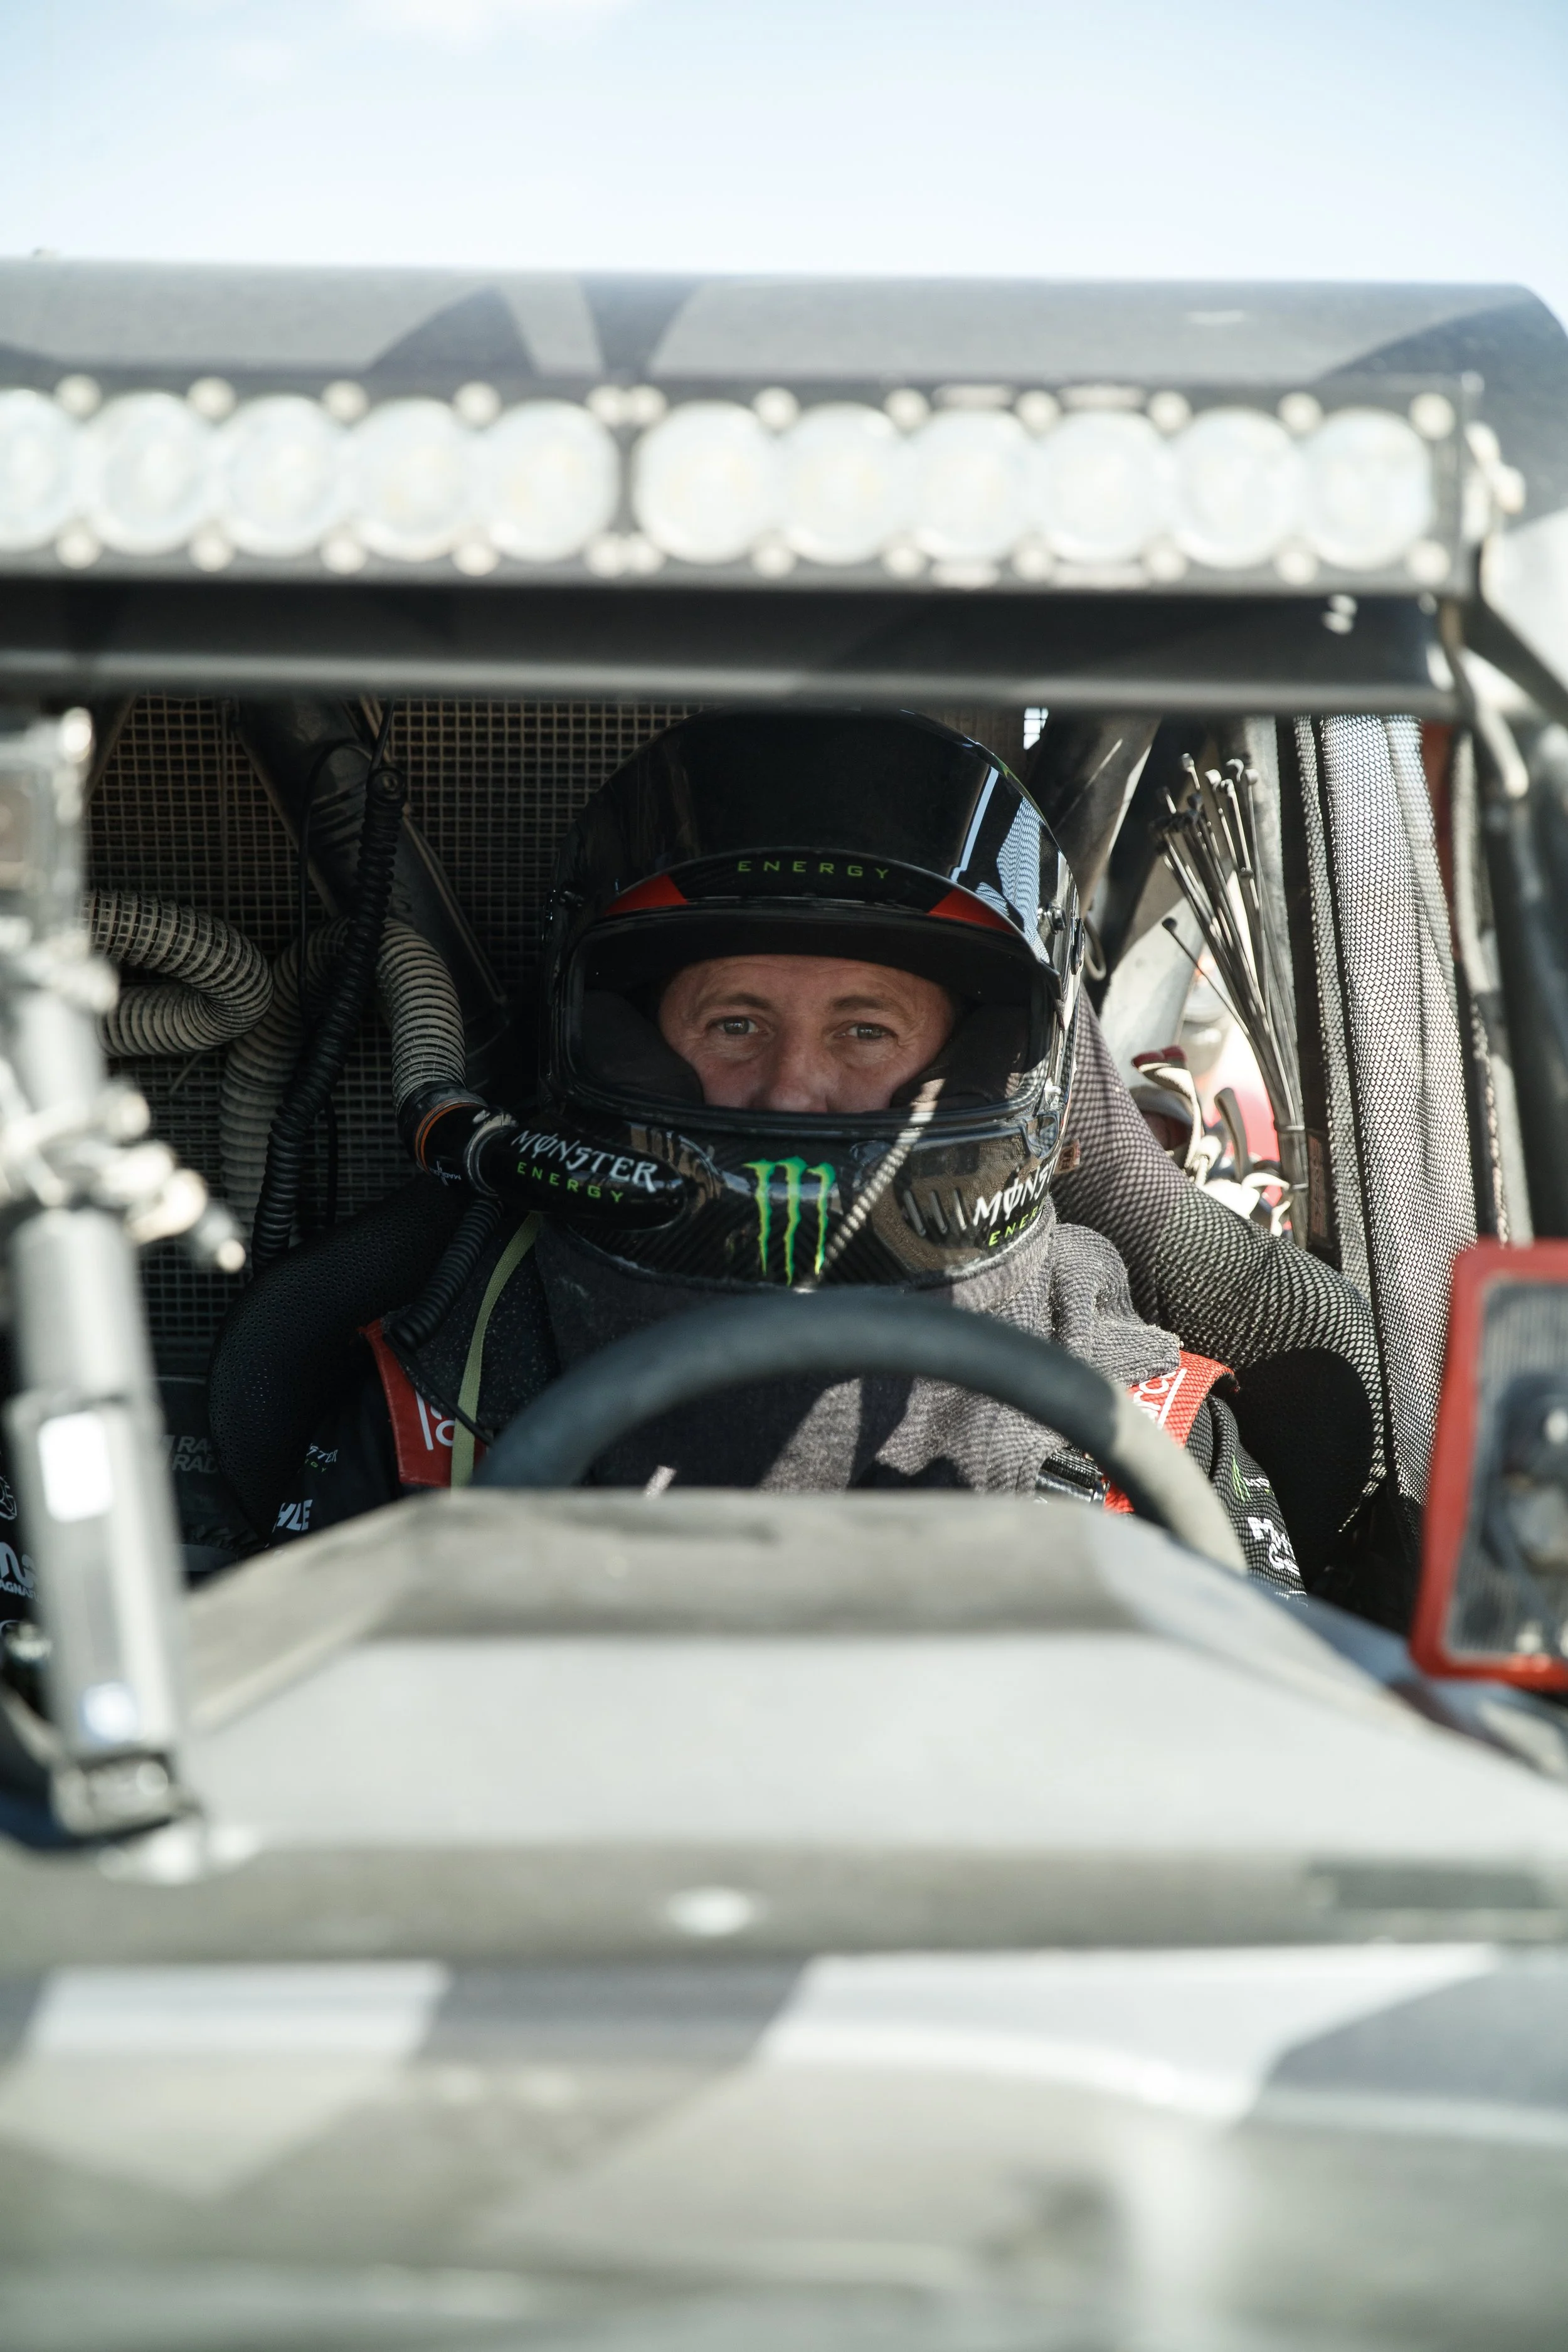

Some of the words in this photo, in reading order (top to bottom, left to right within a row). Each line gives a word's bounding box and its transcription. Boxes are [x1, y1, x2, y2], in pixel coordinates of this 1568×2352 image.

[738, 861, 889, 878] ENERGY
[517, 1160, 623, 1203] ENERGY
[306, 1443, 339, 1463] STER
